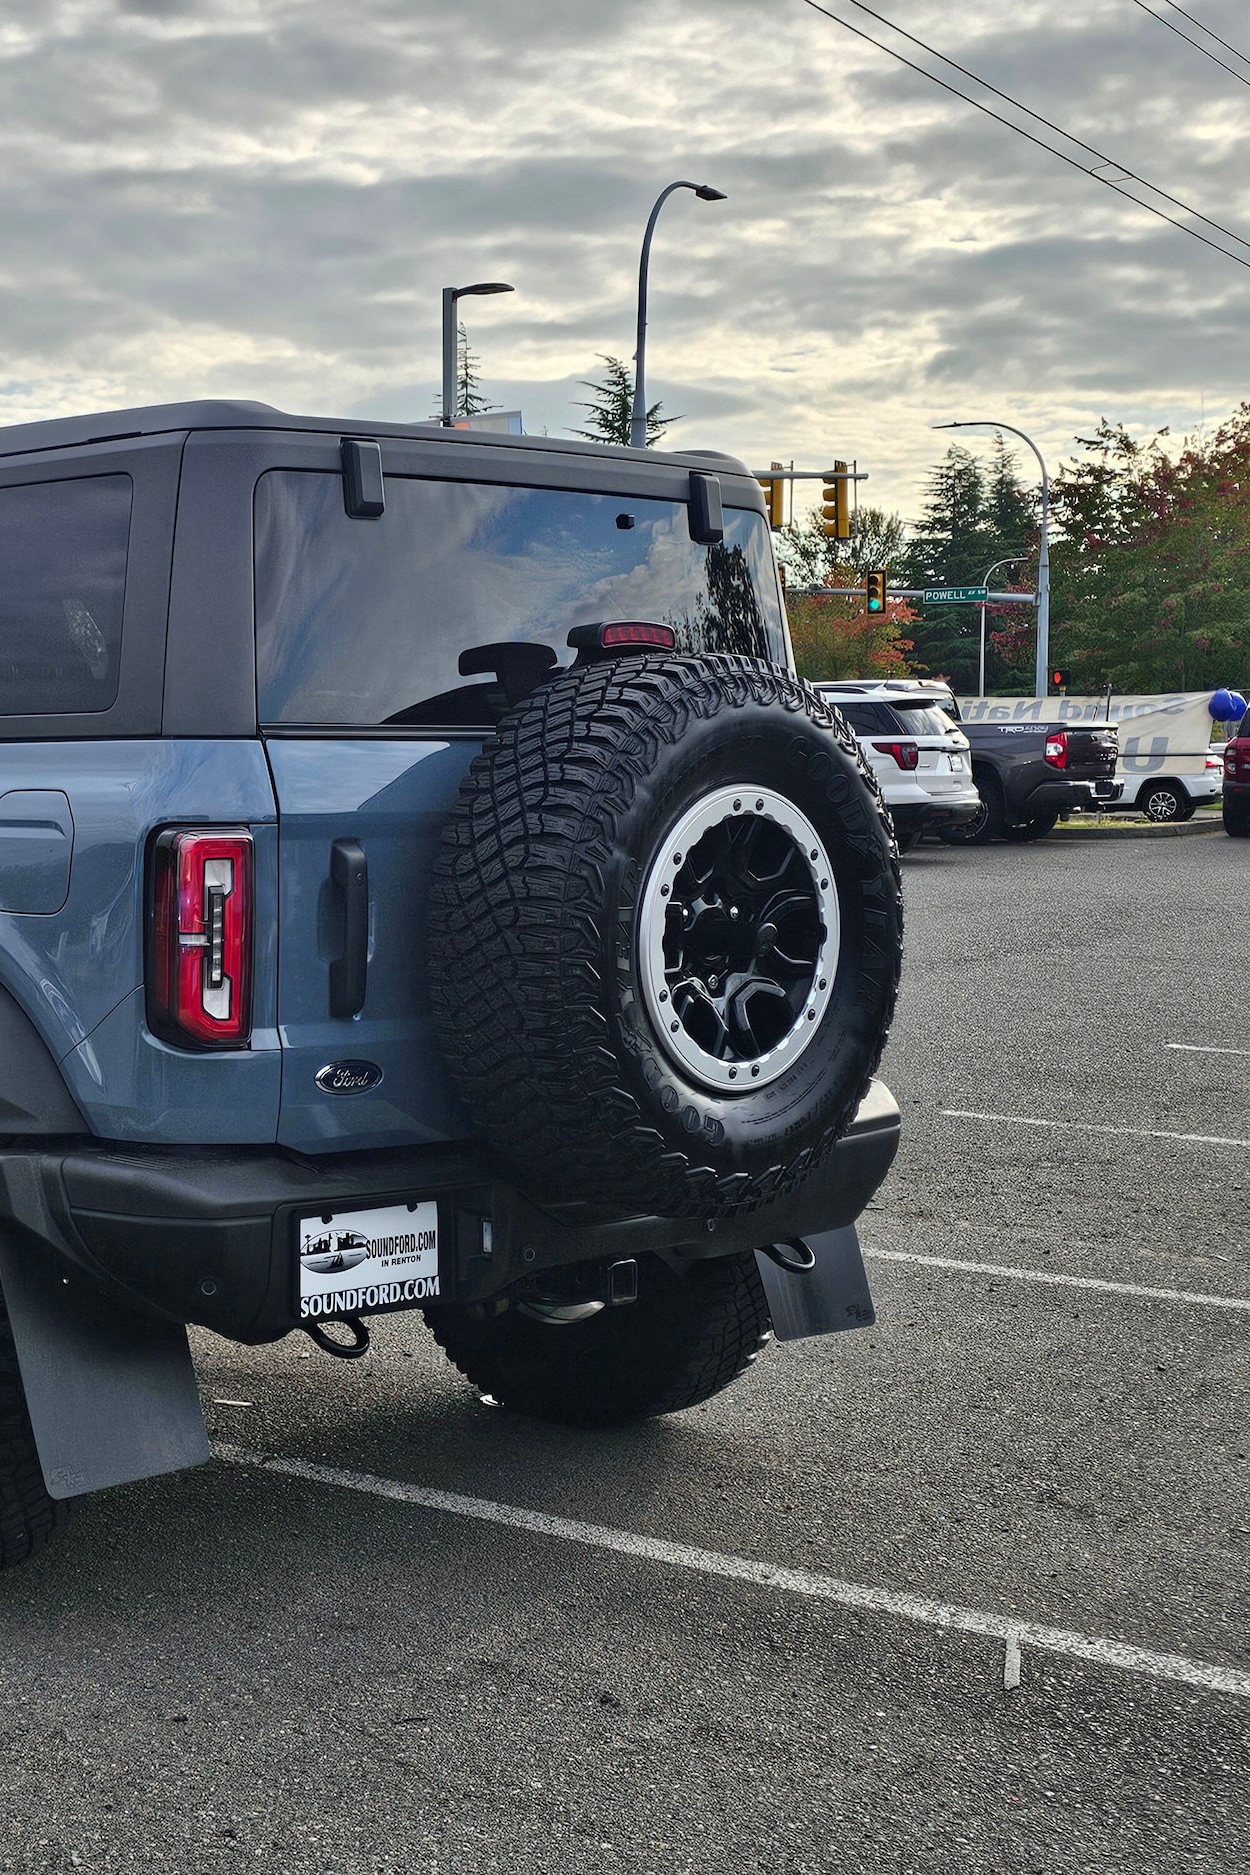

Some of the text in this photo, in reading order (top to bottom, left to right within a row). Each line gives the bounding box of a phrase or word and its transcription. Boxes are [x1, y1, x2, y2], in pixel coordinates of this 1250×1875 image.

[925, 590, 966, 601] POWELL
[332, 1069, 369, 1088] Ford
[365, 1230, 436, 1260] SOUNDFORD.COM
[381, 1255, 421, 1268] IN RENTON
[300, 1275, 441, 1319] SOUNDFORD.COM
